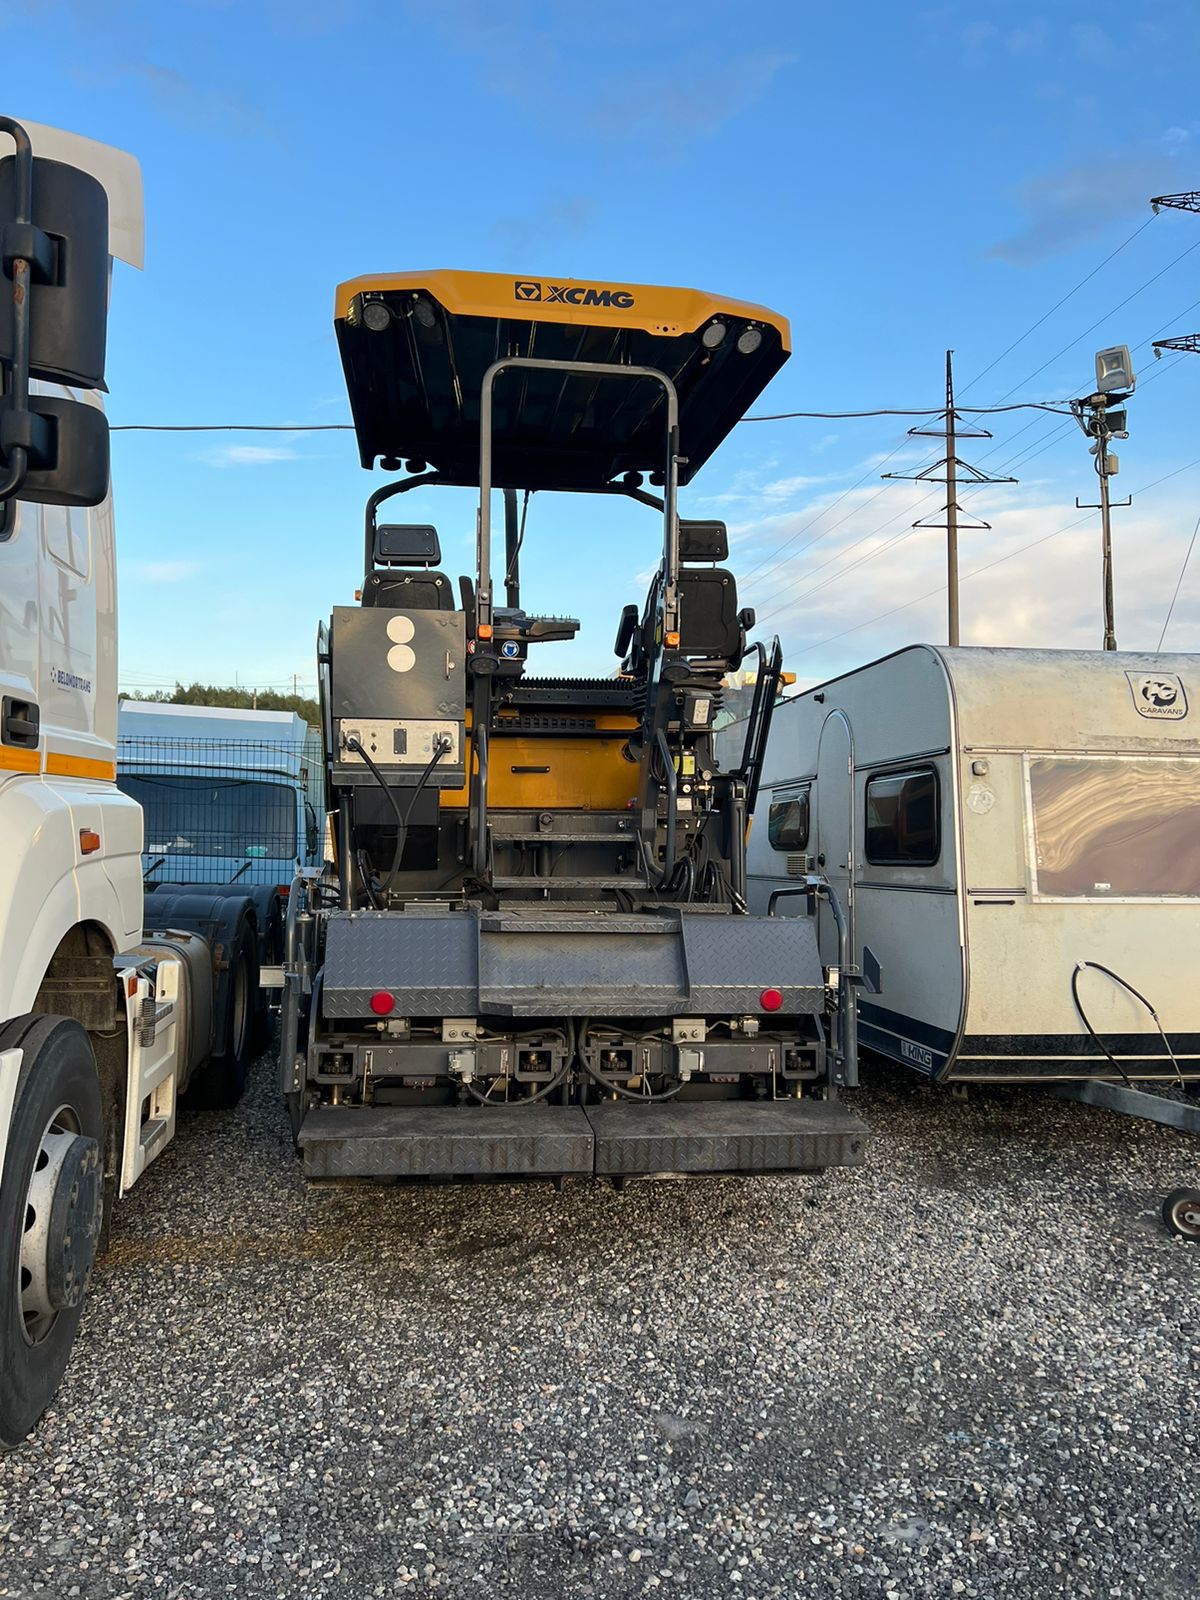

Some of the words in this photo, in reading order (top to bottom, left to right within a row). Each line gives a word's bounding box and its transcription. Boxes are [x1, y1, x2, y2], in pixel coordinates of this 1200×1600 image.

[543, 285, 635, 308] XCMG
[1140, 706, 1184, 715] CARAVANS
[908, 1045, 931, 1065] KING
